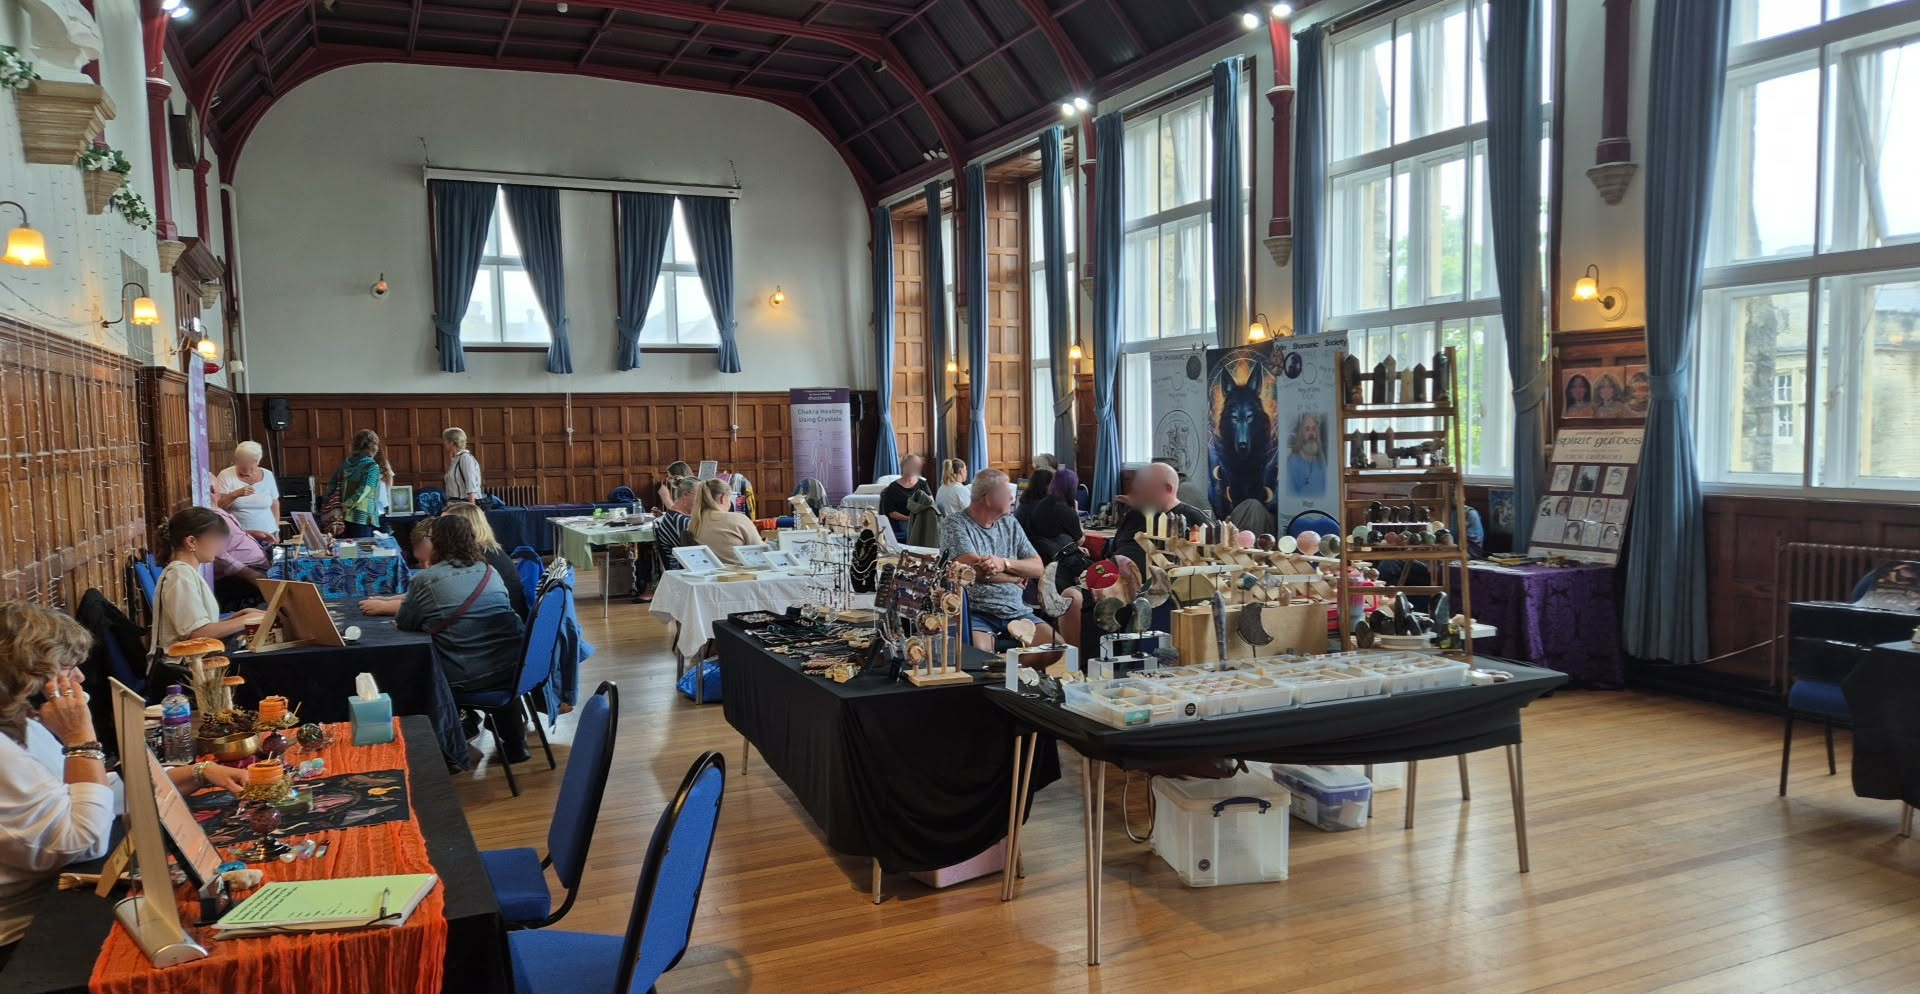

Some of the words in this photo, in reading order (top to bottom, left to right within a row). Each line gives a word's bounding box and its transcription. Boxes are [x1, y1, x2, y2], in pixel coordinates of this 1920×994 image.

[1325, 339, 1348, 347] Society
[820, 408, 843, 416] Healing
[817, 416, 842, 424] Crystals
